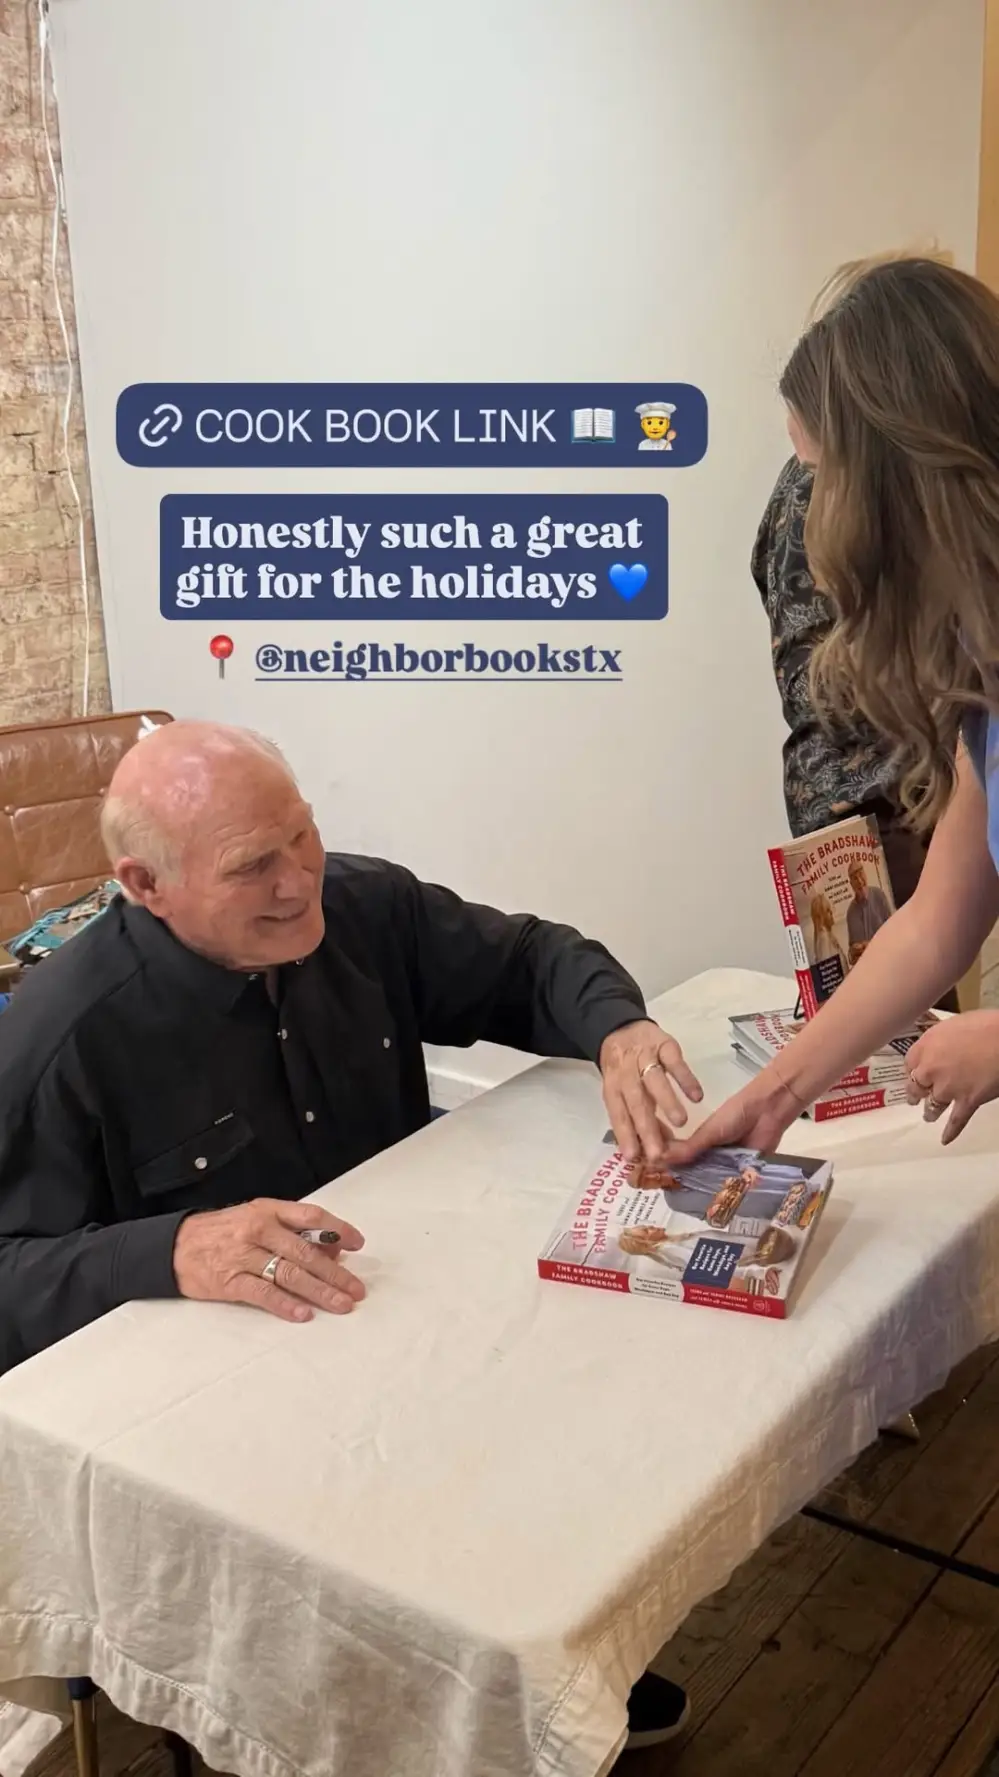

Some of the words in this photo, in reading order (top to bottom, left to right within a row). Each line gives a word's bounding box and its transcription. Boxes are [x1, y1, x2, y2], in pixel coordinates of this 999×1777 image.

[796, 852, 817, 877] THE
[817, 834, 878, 858] BRADSHAW
[801, 862, 829, 895] FAMILY
[832, 852, 880, 867] COOKBOOK
[577, 1152, 623, 1216] BRADSHA
[571, 1221, 589, 1250] THE
[593, 1208, 610, 1253] FAMILY
[551, 1272, 578, 1281] FAMILY
[580, 1277, 623, 1289] COOKBOOK
[556, 1264, 571, 1272] THE
[573, 1267, 617, 1280] BRADSHAW
